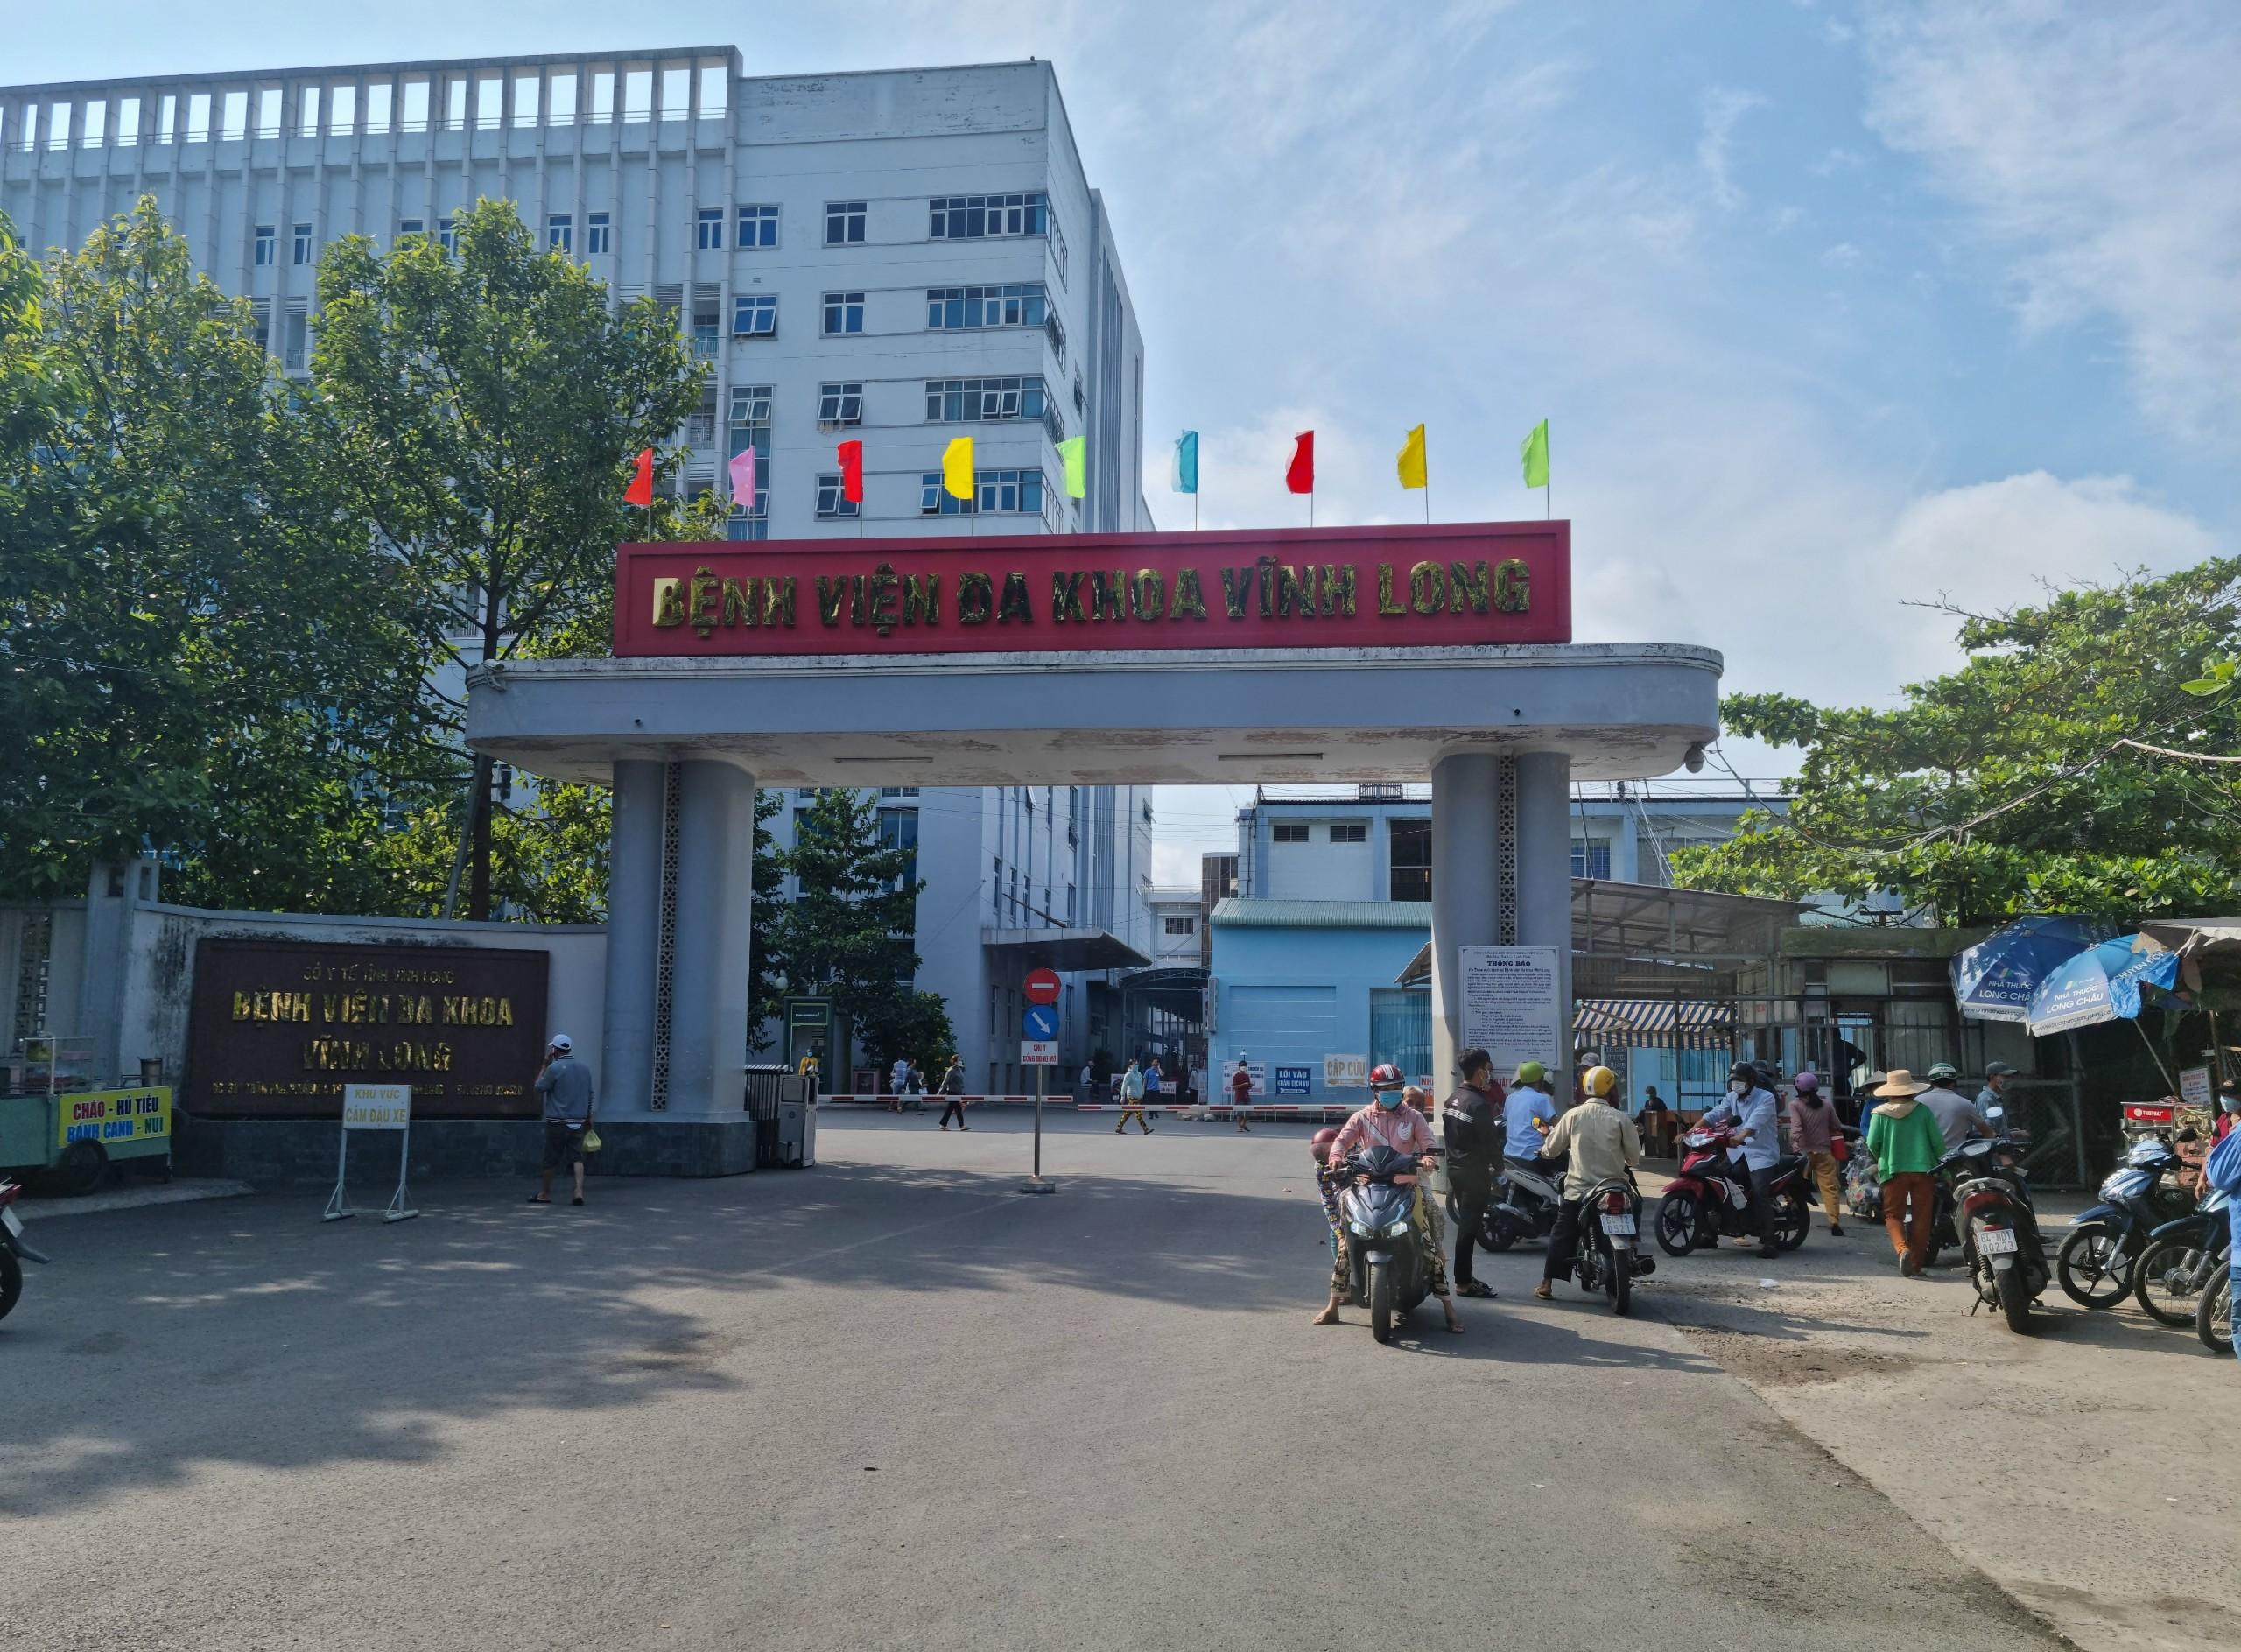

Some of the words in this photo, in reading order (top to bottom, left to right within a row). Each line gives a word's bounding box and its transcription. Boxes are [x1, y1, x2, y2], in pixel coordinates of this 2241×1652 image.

[653, 566, 796, 636] BỆNH
[814, 563, 939, 635] VIỆN
[1052, 568, 1207, 622] KHOA
[1220, 555, 1356, 616] VĨNH
[1379, 558, 1530, 614] LONG
[1979, 989, 2007, 999] LONG
[2010, 991, 2031, 1002] CHÂ
[2046, 1000, 2075, 1014] LONG
[2076, 992, 2104, 1007] CHÂU
[231, 984, 313, 1028] BỆNH
[322, 987, 390, 1030] VIỆN
[442, 995, 515, 1026] KHOA
[355, 1088, 376, 1100] KHU
[391, 1107, 407, 1123] XE
[103, 1120, 134, 1139] CANH
[144, 1116, 164, 1135] NUI
